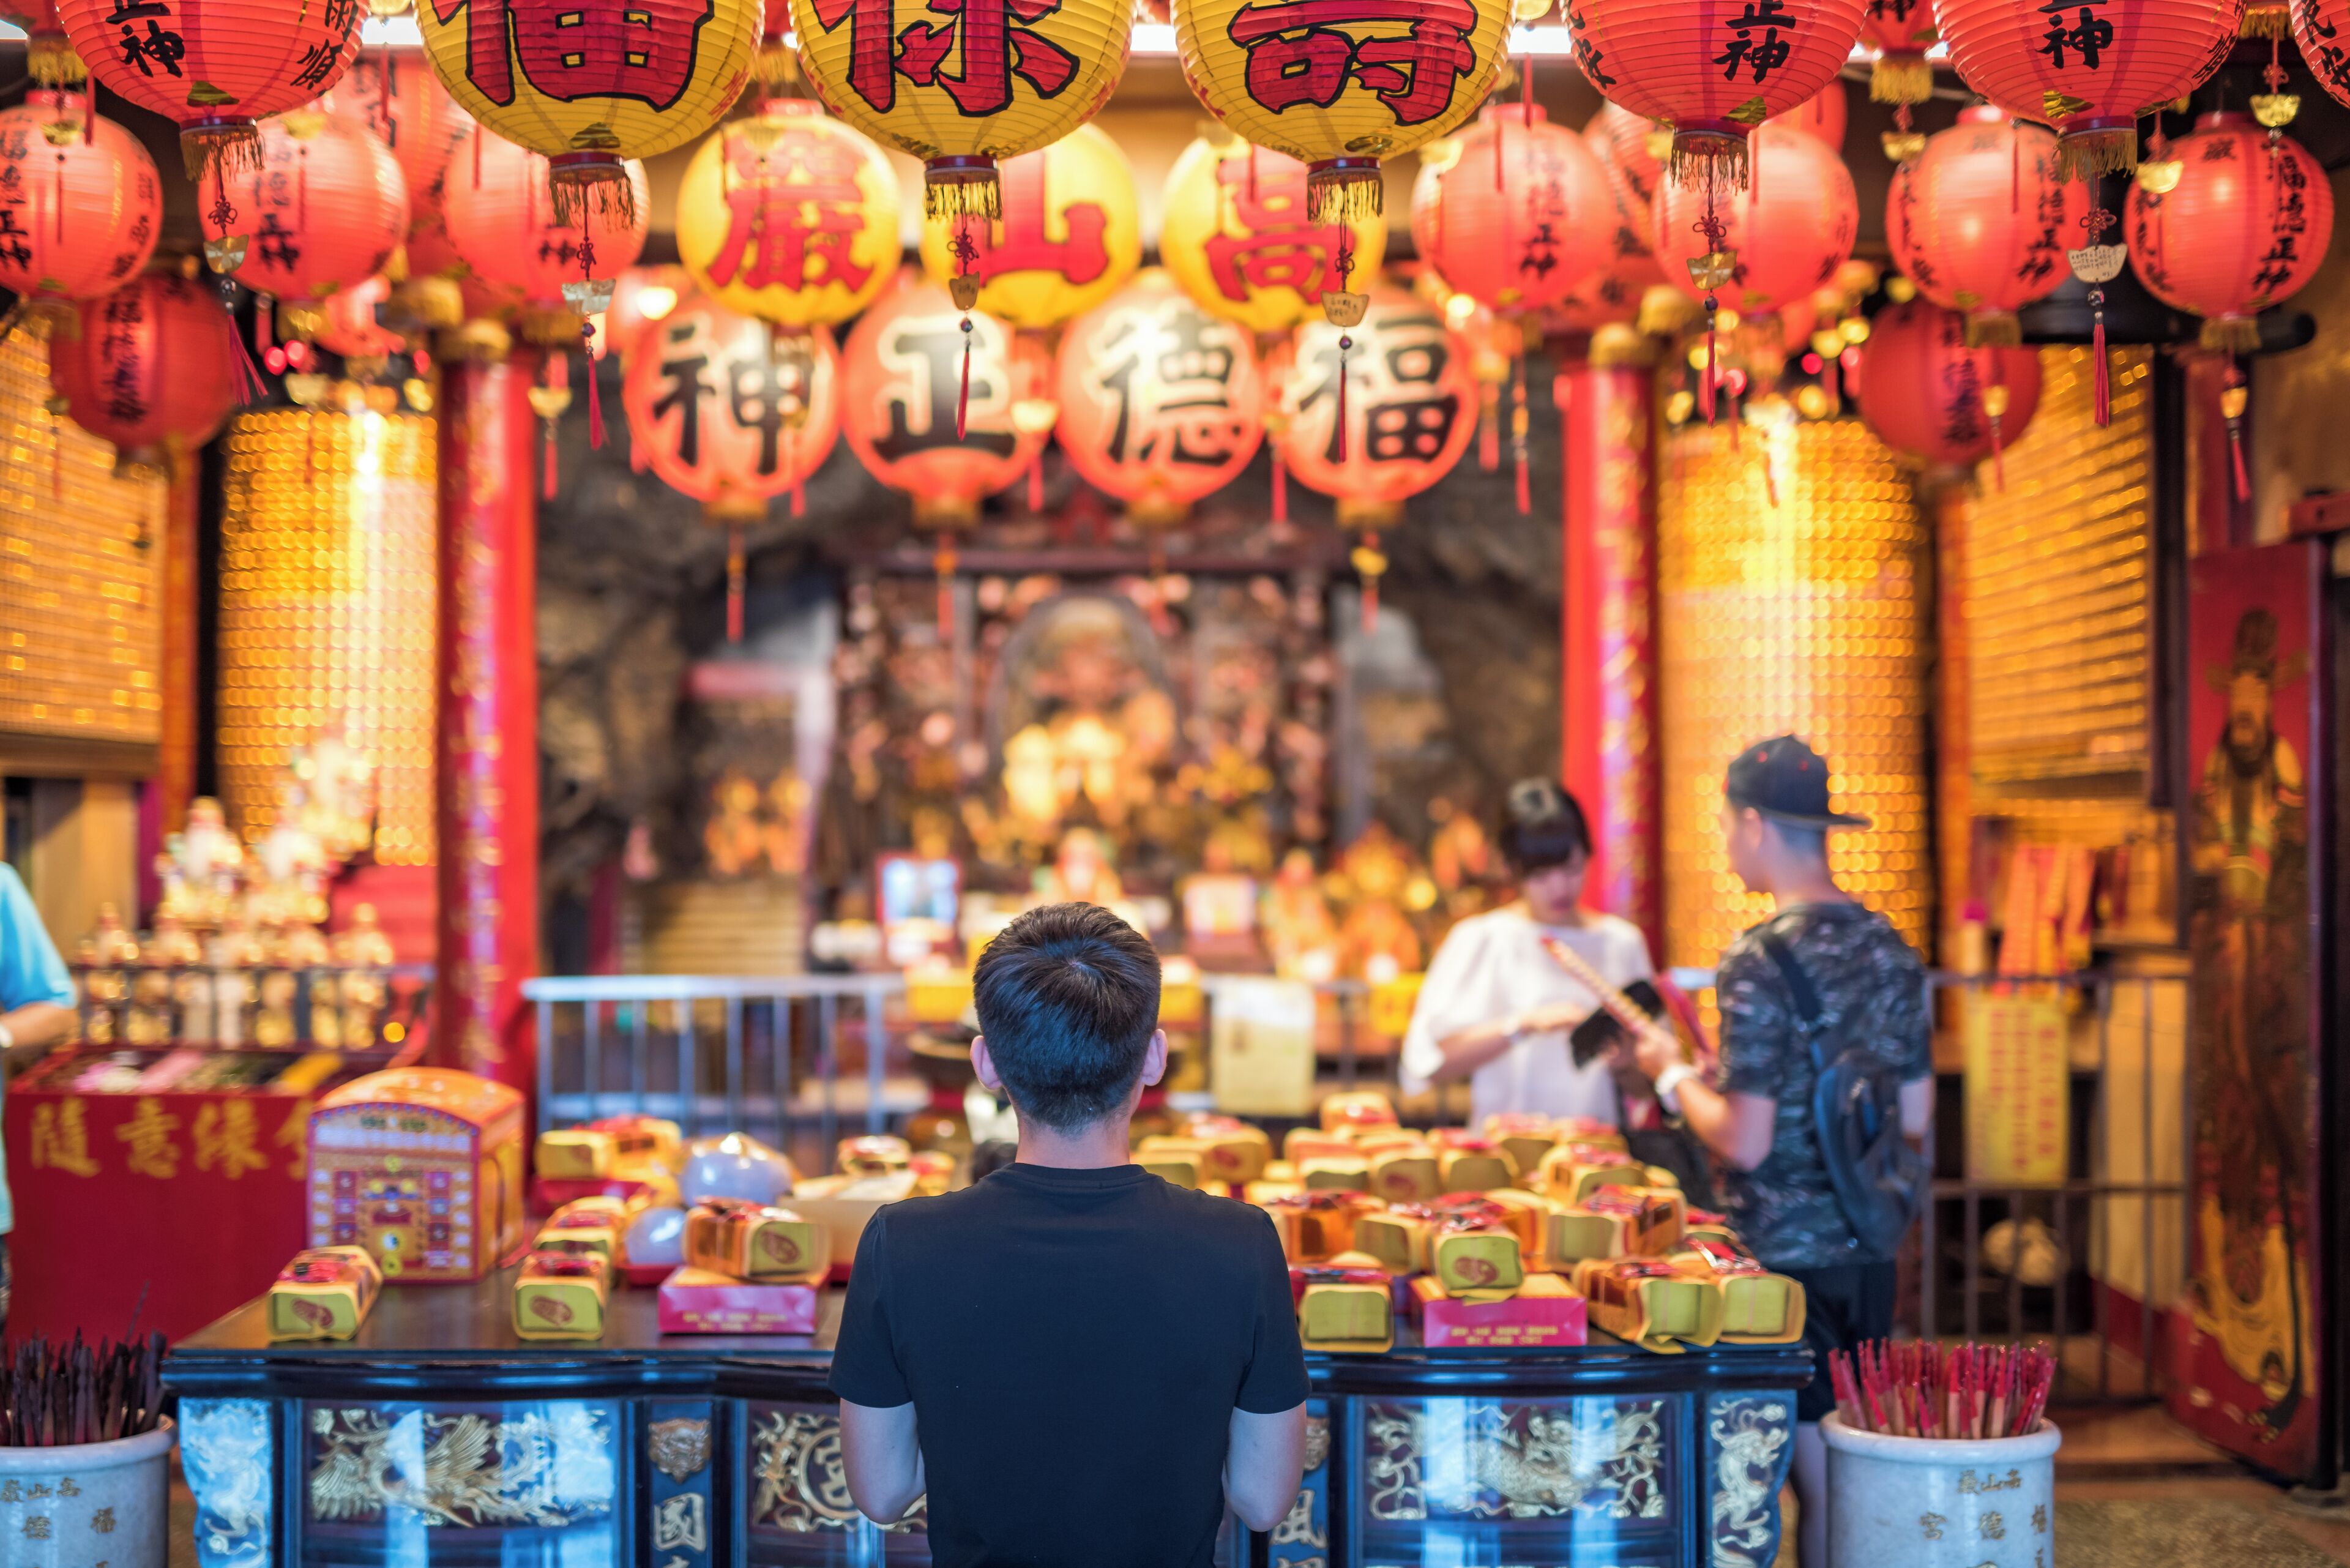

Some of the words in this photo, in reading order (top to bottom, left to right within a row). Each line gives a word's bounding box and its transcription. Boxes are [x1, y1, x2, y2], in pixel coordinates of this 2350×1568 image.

[871, 333, 1017, 464] 正
[1101, 312, 1241, 468] 德
[1297, 315, 1457, 465] 福
